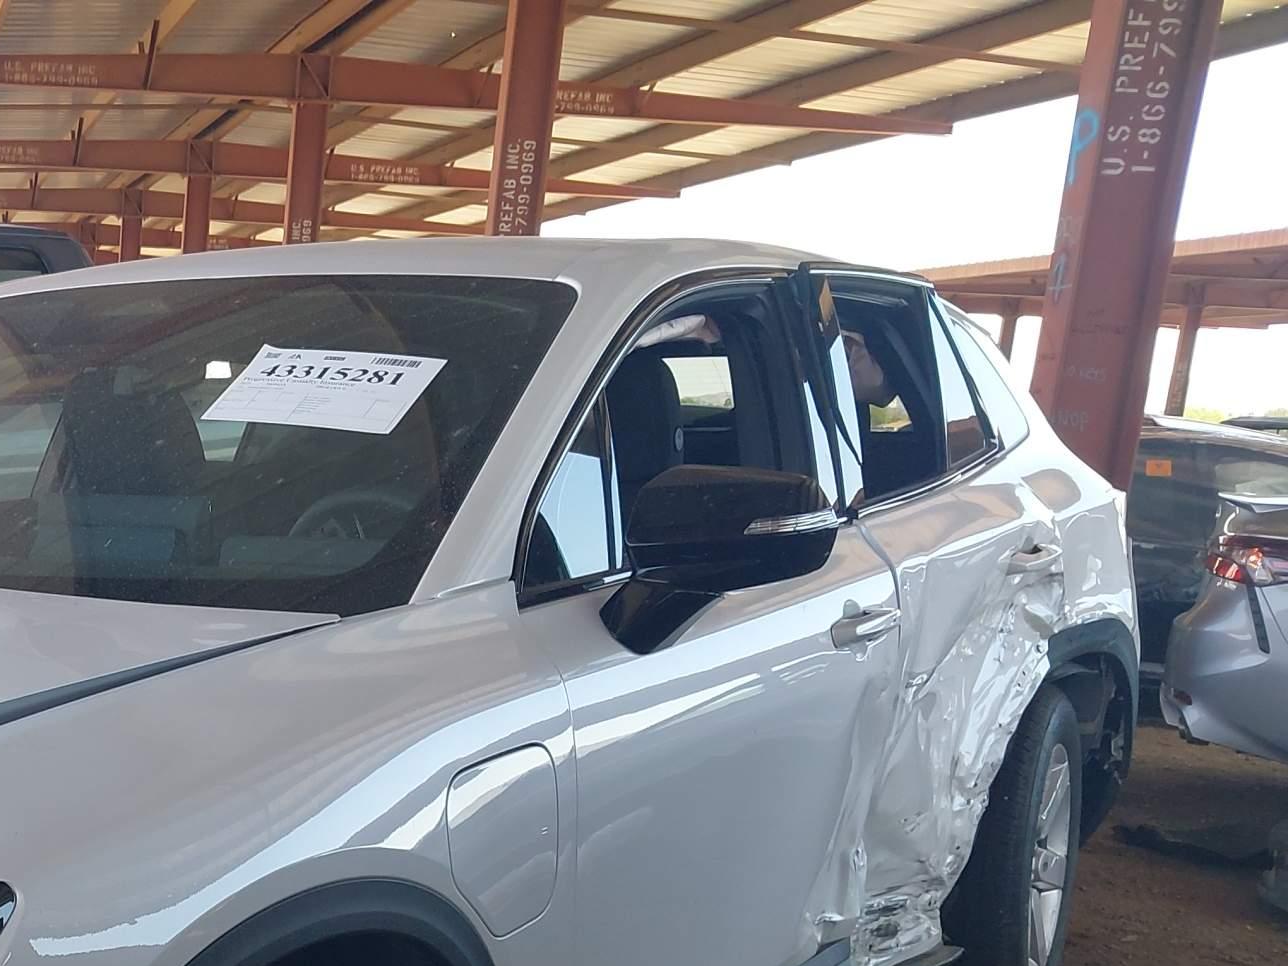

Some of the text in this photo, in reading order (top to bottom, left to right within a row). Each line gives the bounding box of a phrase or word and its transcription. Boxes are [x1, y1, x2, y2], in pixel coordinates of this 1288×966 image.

[555, 89, 591, 102] REFAB
[1100, 0, 1159, 176] U.S. PREF
[498, 138, 522, 236] REFAB INC.
[259, 364, 405, 385] 43315281
